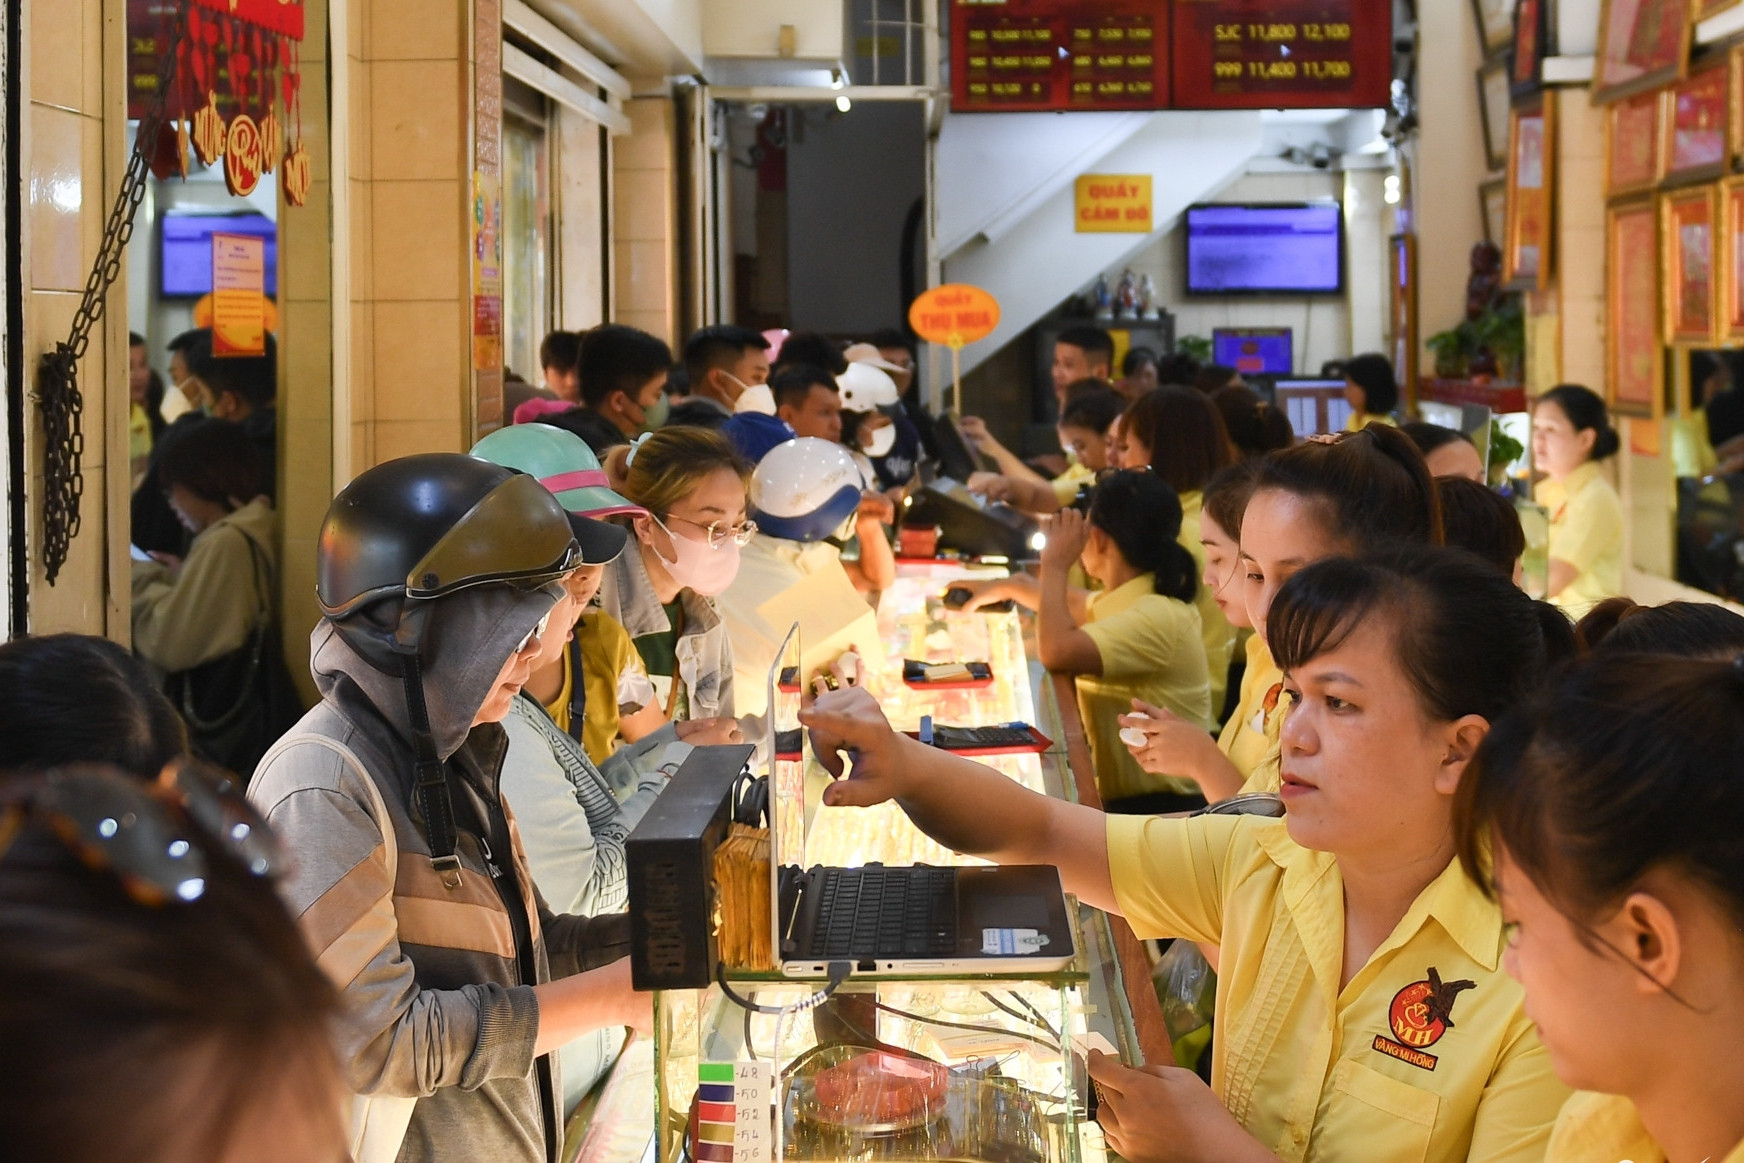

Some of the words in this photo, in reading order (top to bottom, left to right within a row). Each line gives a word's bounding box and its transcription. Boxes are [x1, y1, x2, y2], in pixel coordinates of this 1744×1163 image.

[1214, 24, 1242, 40] SJC
[1249, 24, 1296, 41] 11,800
[1214, 61, 1242, 77] 999
[1249, 61, 1296, 79] 11,400
[956, 311, 991, 329] MUA
[1393, 1016, 1434, 1046] MH
[1375, 1038, 1400, 1056] VÀNG
[1409, 1052, 1435, 1069] HỒNG
